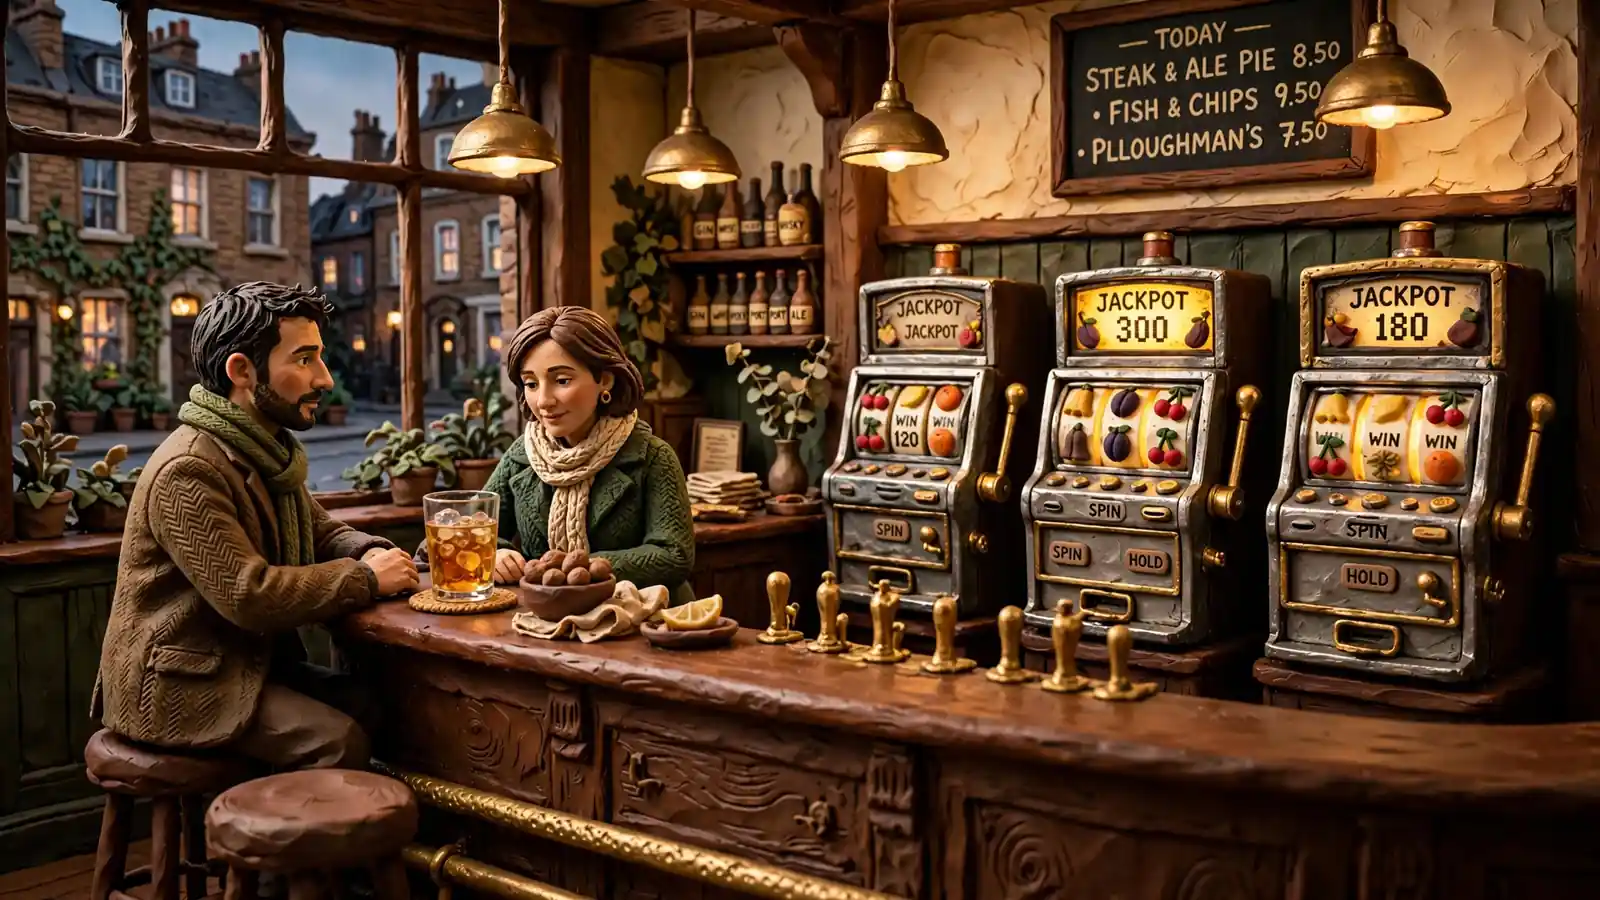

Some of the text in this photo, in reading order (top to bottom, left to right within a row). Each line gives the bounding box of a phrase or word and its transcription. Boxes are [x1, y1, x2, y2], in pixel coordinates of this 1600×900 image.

[1154, 21, 1227, 50] TODAY
[1086, 41, 1341, 93] STEAK & ALE PIE 8.50
[1109, 80, 1322, 125] FISH & CHIPS 9.50
[1092, 120, 1328, 165] PLLOUGHMAN'S 7.50
[1096, 290, 1189, 312] JACKPOT
[1350, 285, 1456, 309] JACKPOT
[791, 310, 807, 320] ALE
[896, 298, 963, 318] JACKPOT
[904, 324, 959, 340] JACKPOT
[1116, 316, 1168, 343] 300
[1375, 312, 1429, 341] 180
[895, 414, 918, 427] WIN
[932, 416, 955, 428] WIN
[894, 430, 919, 448] 120
[1368, 431, 1401, 448] WIN
[1425, 434, 1457, 450] WIN
[1088, 503, 1121, 519] SPIN
[876, 522, 904, 537] SPIN
[1053, 545, 1082, 561] SPIN
[1128, 553, 1164, 569] HOLD
[1347, 567, 1389, 587] HOLD
